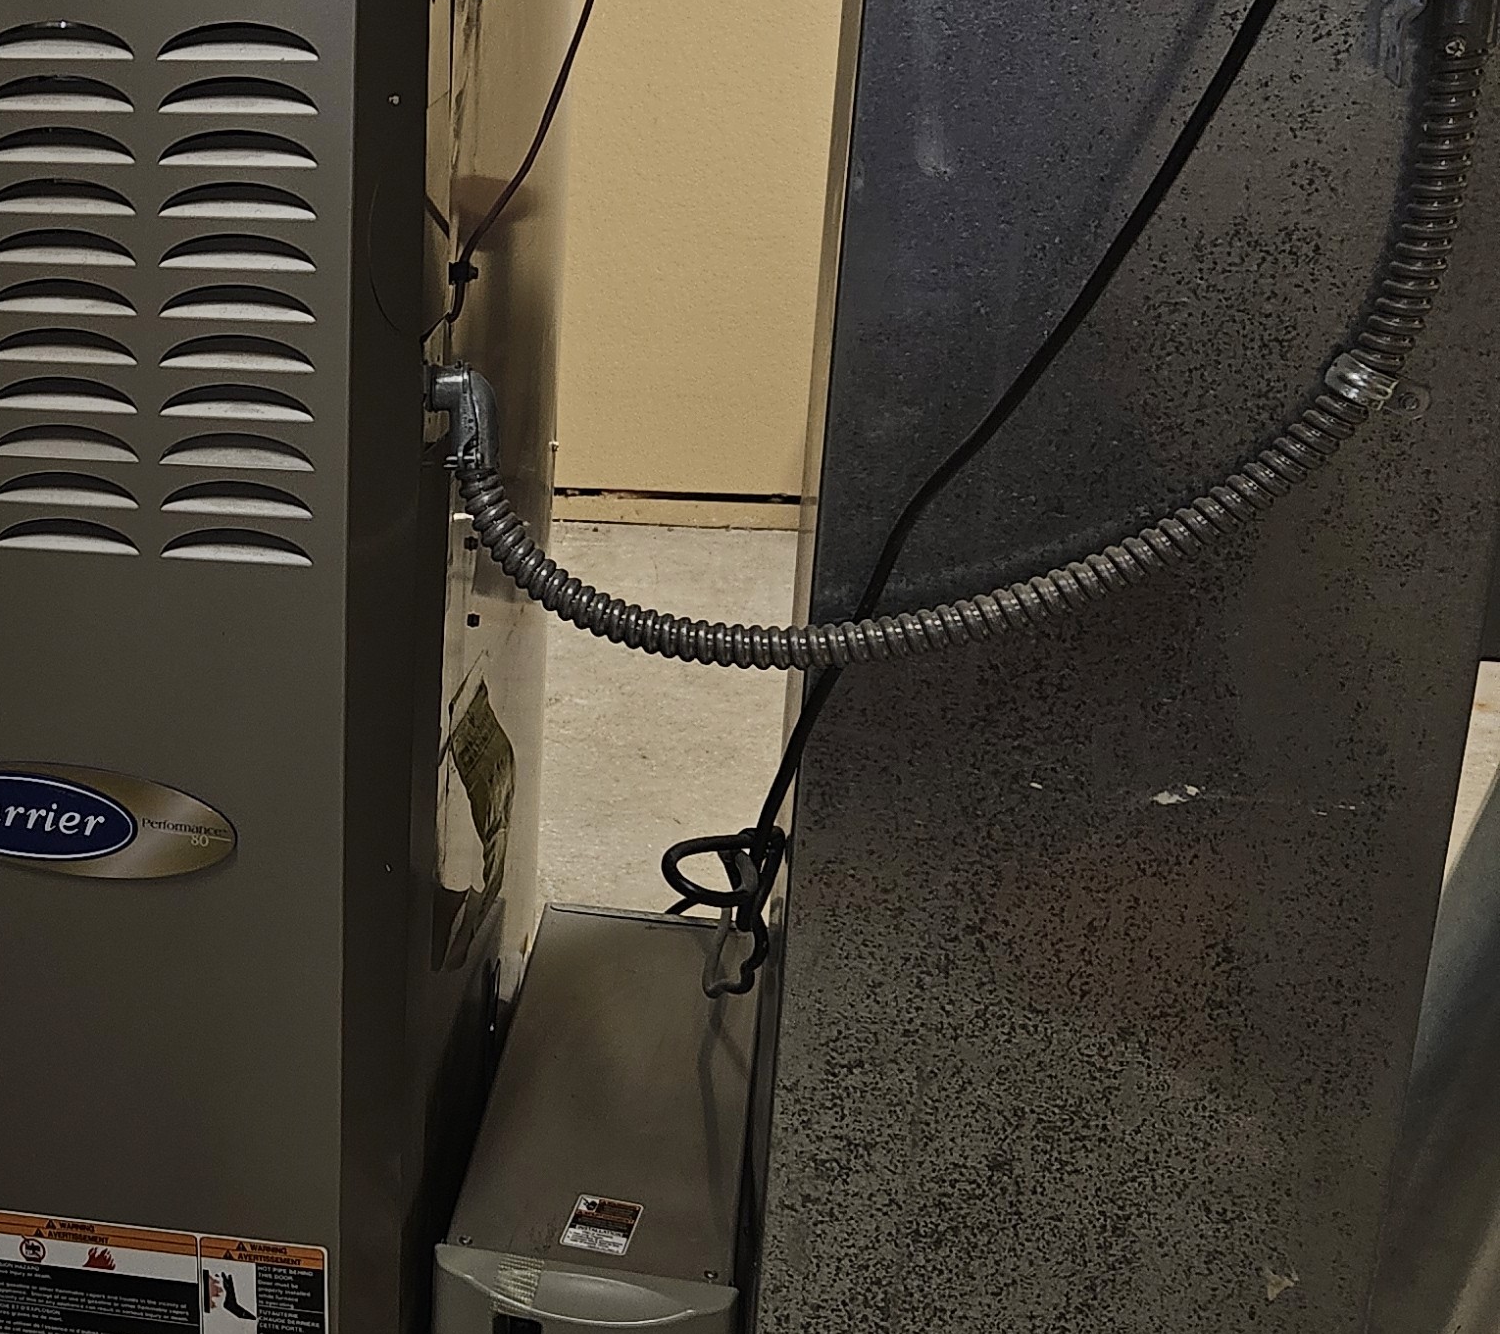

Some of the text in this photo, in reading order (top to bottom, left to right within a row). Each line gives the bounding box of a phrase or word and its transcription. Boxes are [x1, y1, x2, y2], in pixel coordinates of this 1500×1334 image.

[141, 817, 220, 836] Performance
[190, 834, 209, 848] 80
[59, 1222, 95, 1233] WARNING
[249, 1244, 288, 1255] WARNING
[237, 1252, 302, 1266] AVERTISSEMENT
